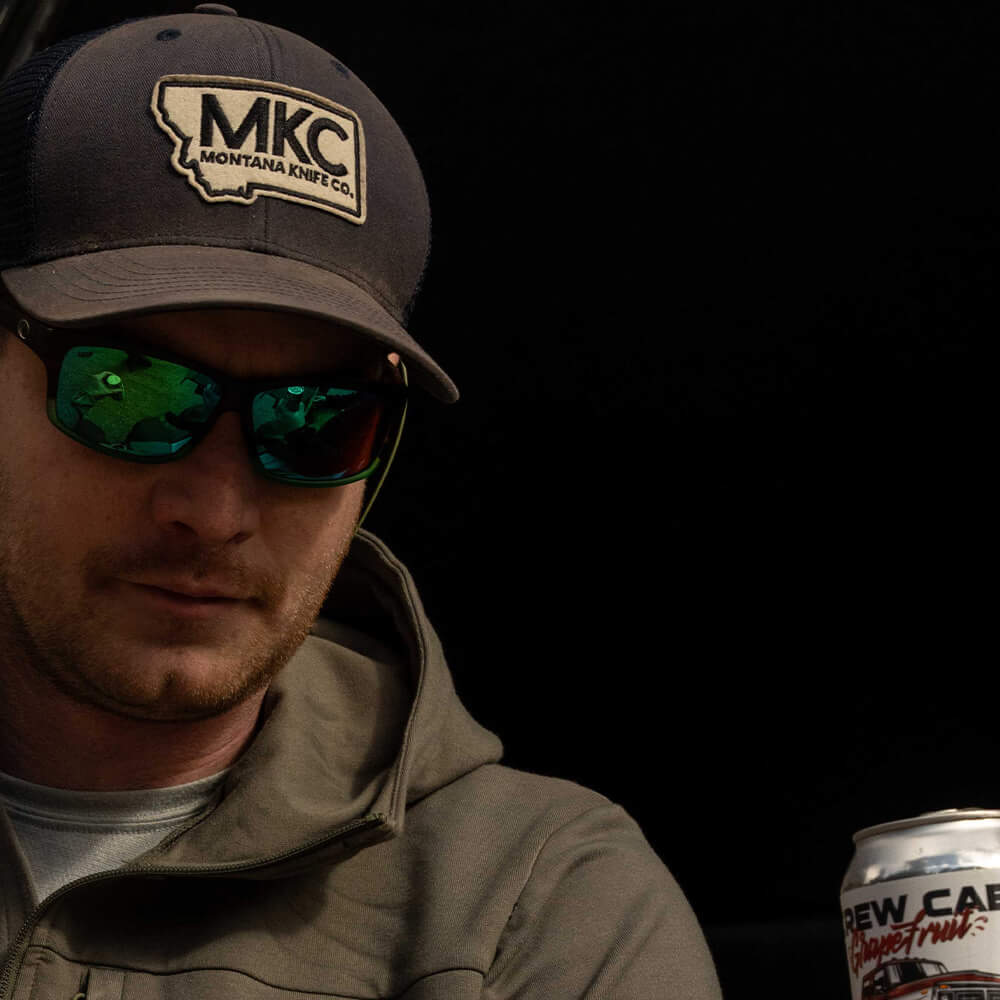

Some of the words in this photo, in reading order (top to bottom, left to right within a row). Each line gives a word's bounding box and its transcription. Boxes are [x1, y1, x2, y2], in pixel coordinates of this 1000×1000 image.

[200, 93, 349, 177] MKC
[200, 151, 286, 174] MONTANA
[288, 163, 329, 187] KNIFE
[331, 178, 354, 199] CO.
